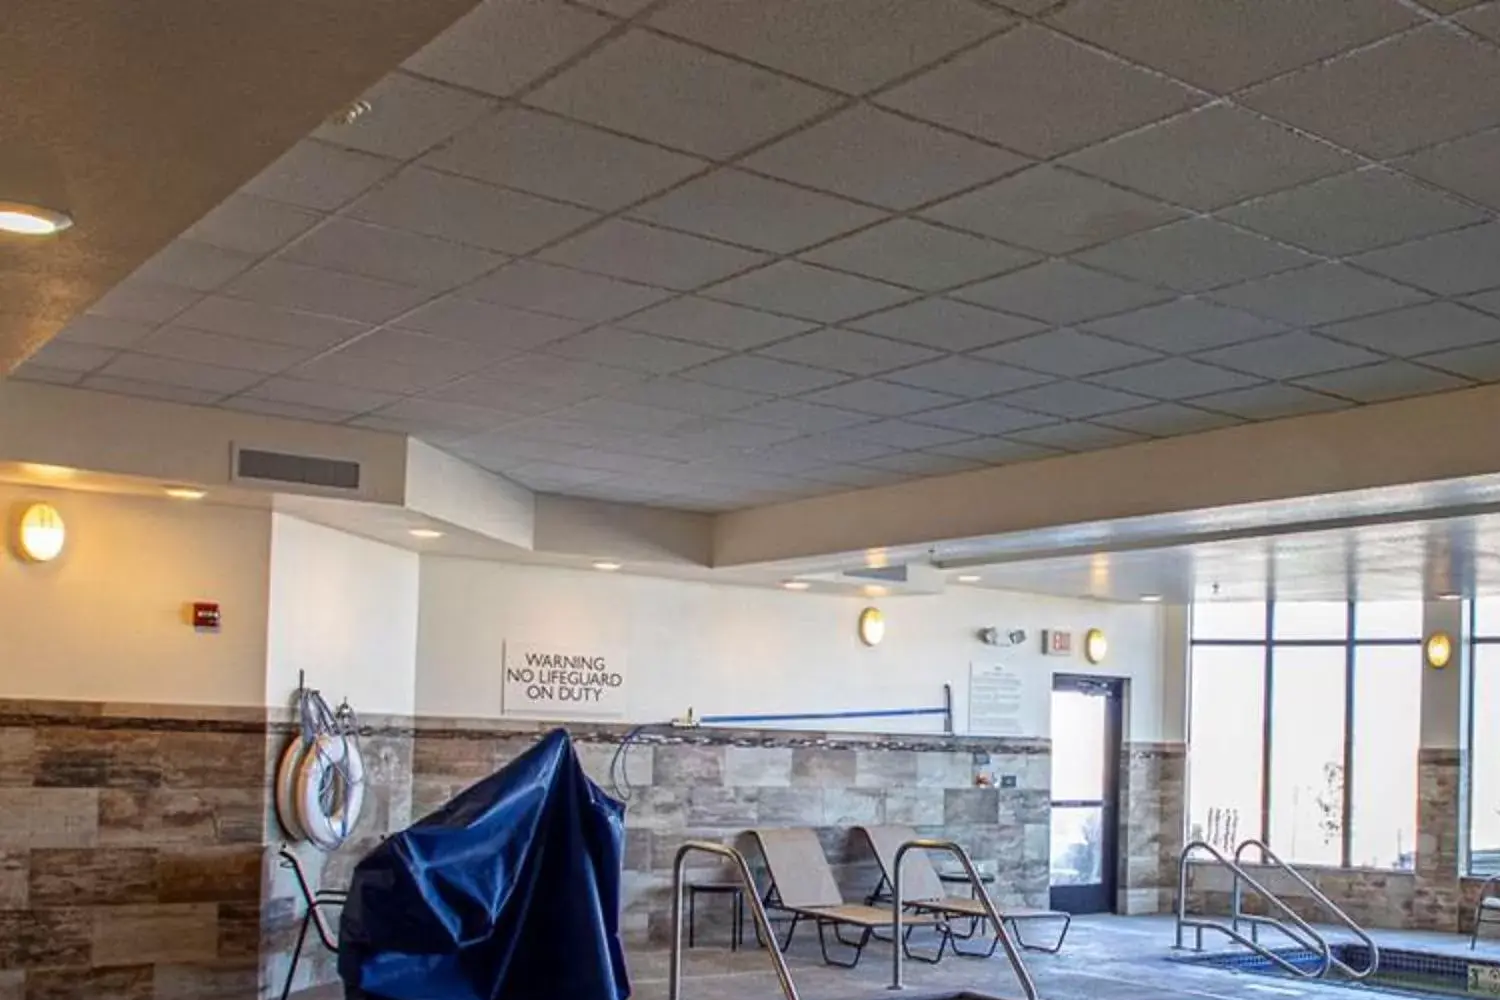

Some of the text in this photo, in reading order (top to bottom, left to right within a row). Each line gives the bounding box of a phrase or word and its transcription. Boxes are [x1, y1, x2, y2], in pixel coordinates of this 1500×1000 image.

[525, 653, 605, 671] WARNING
[507, 668, 623, 687] NO LIFEGUARD
[527, 684, 602, 701] ON DUTY
